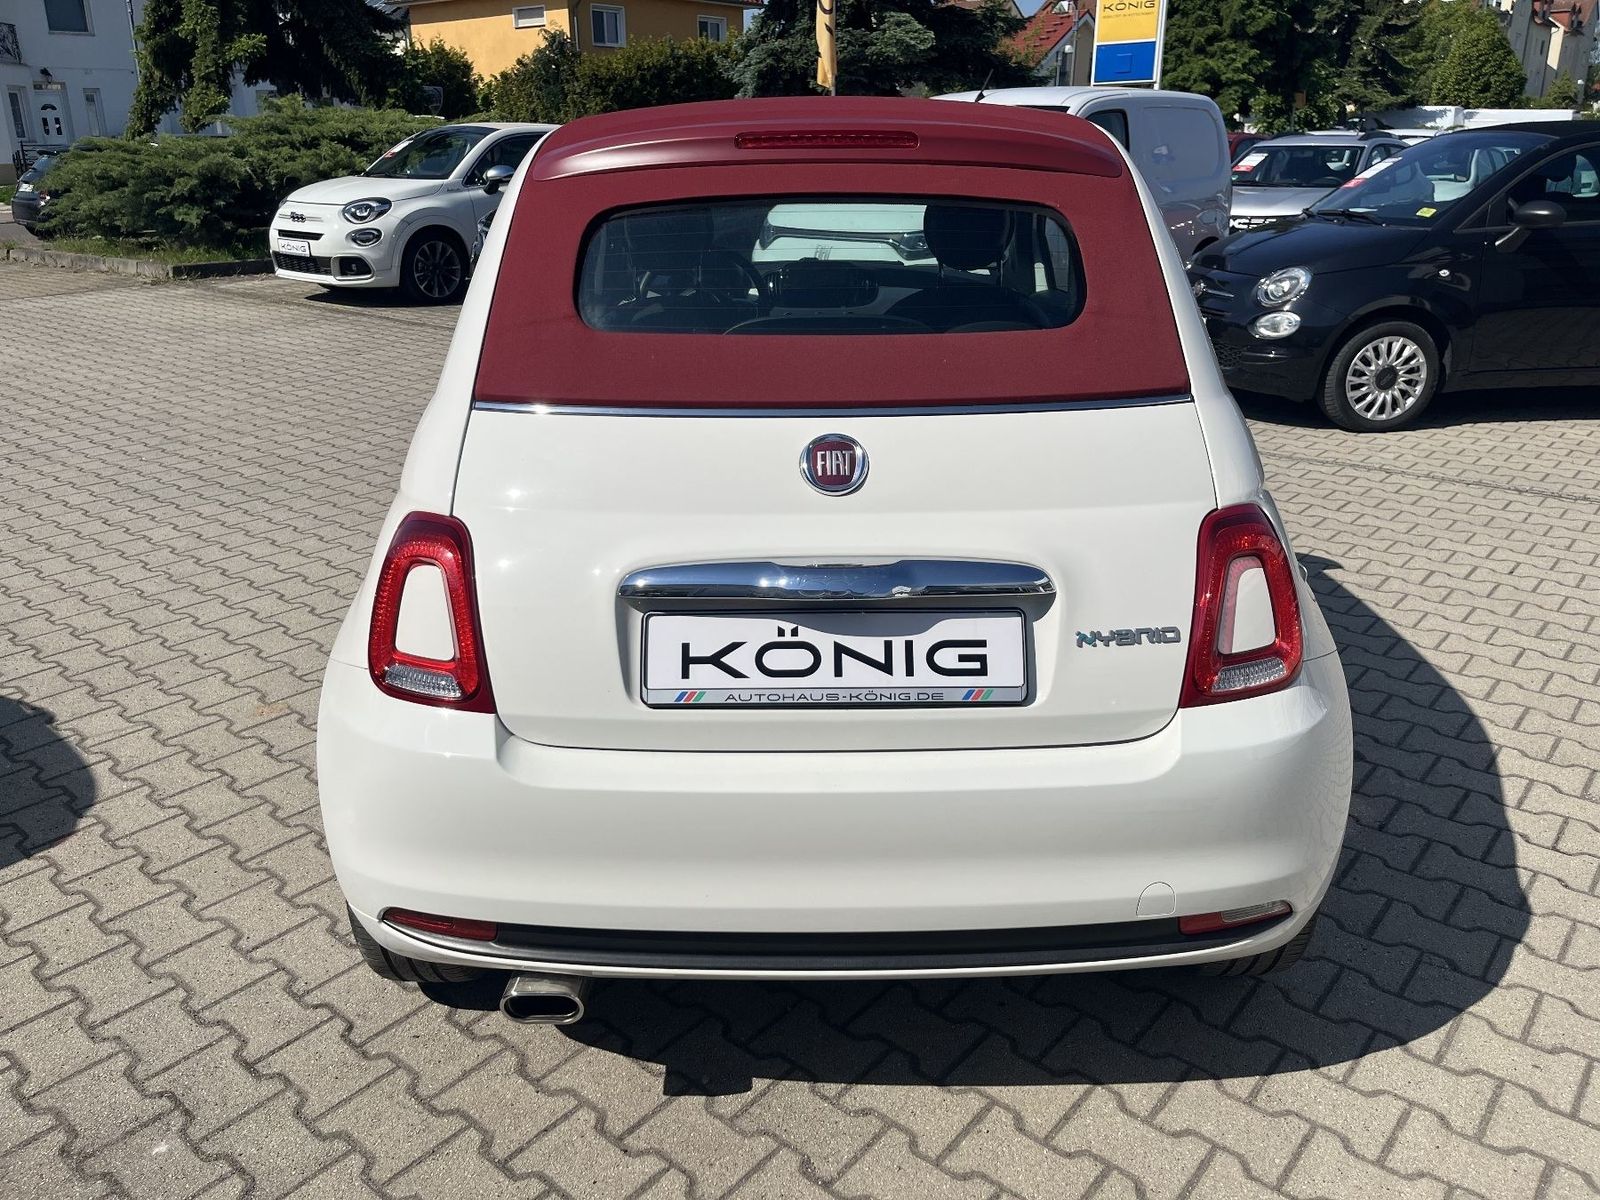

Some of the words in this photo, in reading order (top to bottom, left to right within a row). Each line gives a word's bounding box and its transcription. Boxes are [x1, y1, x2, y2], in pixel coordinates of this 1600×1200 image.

[1103, 0, 1156, 12] KÖNIG
[816, 450, 853, 477] FIAT
[1075, 626, 1182, 649] HYBRID
[681, 625, 989, 679] KÖNIG
[724, 690, 944, 702] AUTOHAUS-KÖNIG.DE
